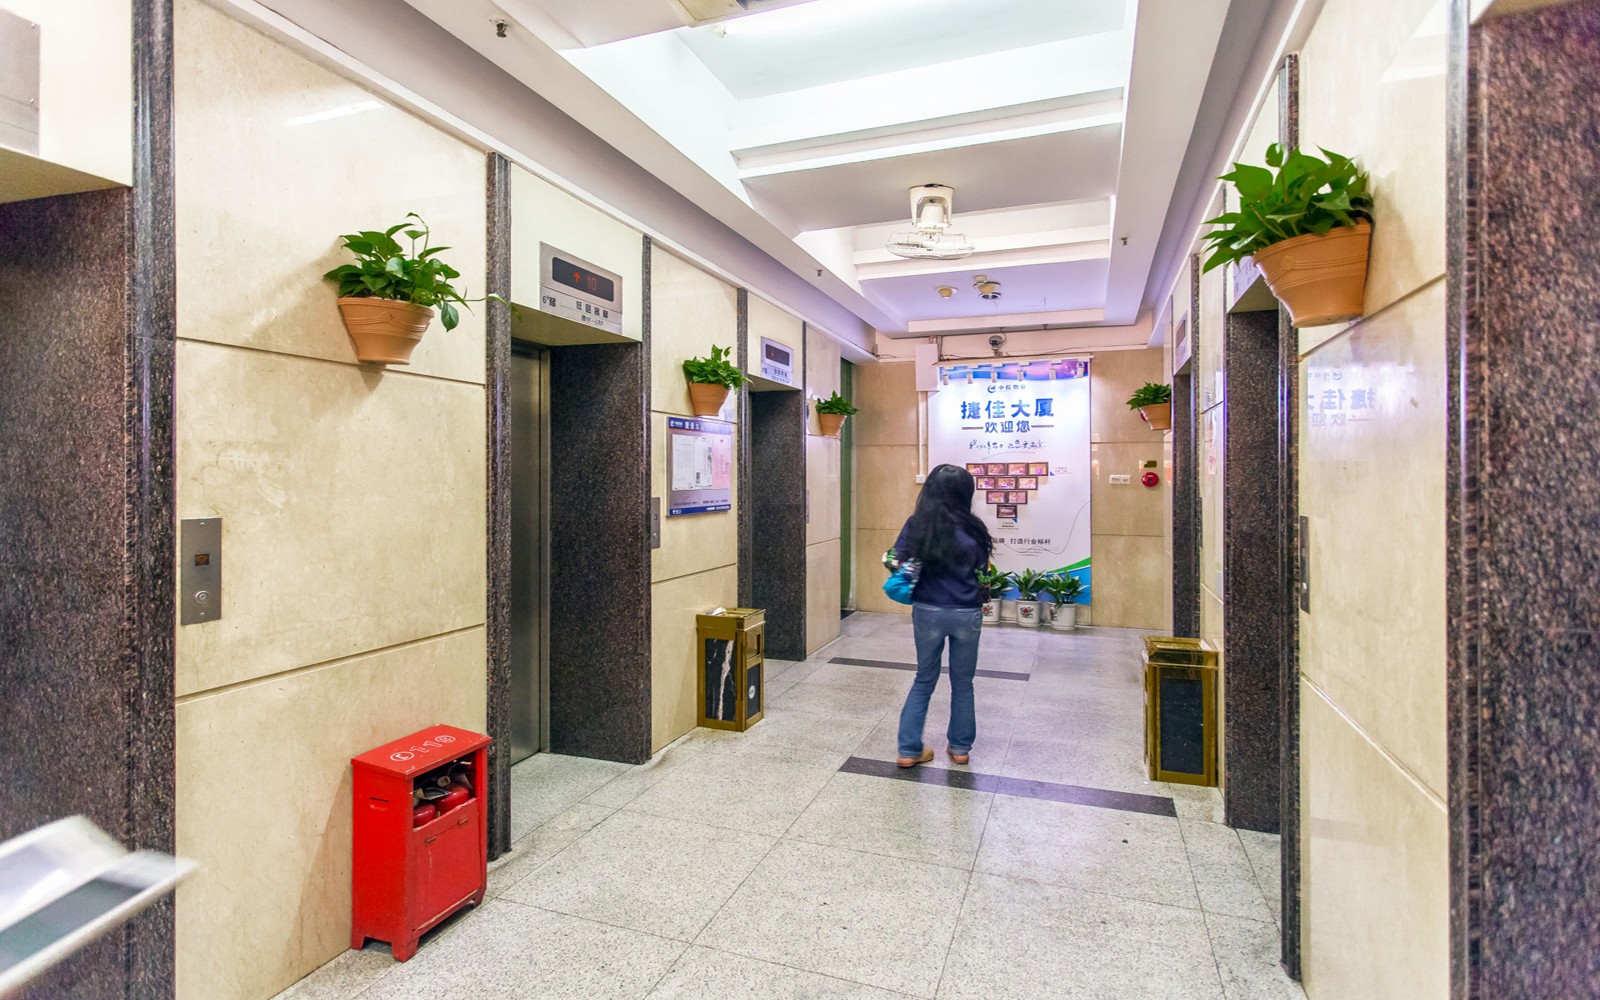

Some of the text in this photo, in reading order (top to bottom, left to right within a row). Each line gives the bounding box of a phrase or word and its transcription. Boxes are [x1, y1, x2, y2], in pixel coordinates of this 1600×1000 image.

[961, 398, 1054, 420] 捷佳大厦
[984, 420, 1031, 434] 欢迎您
